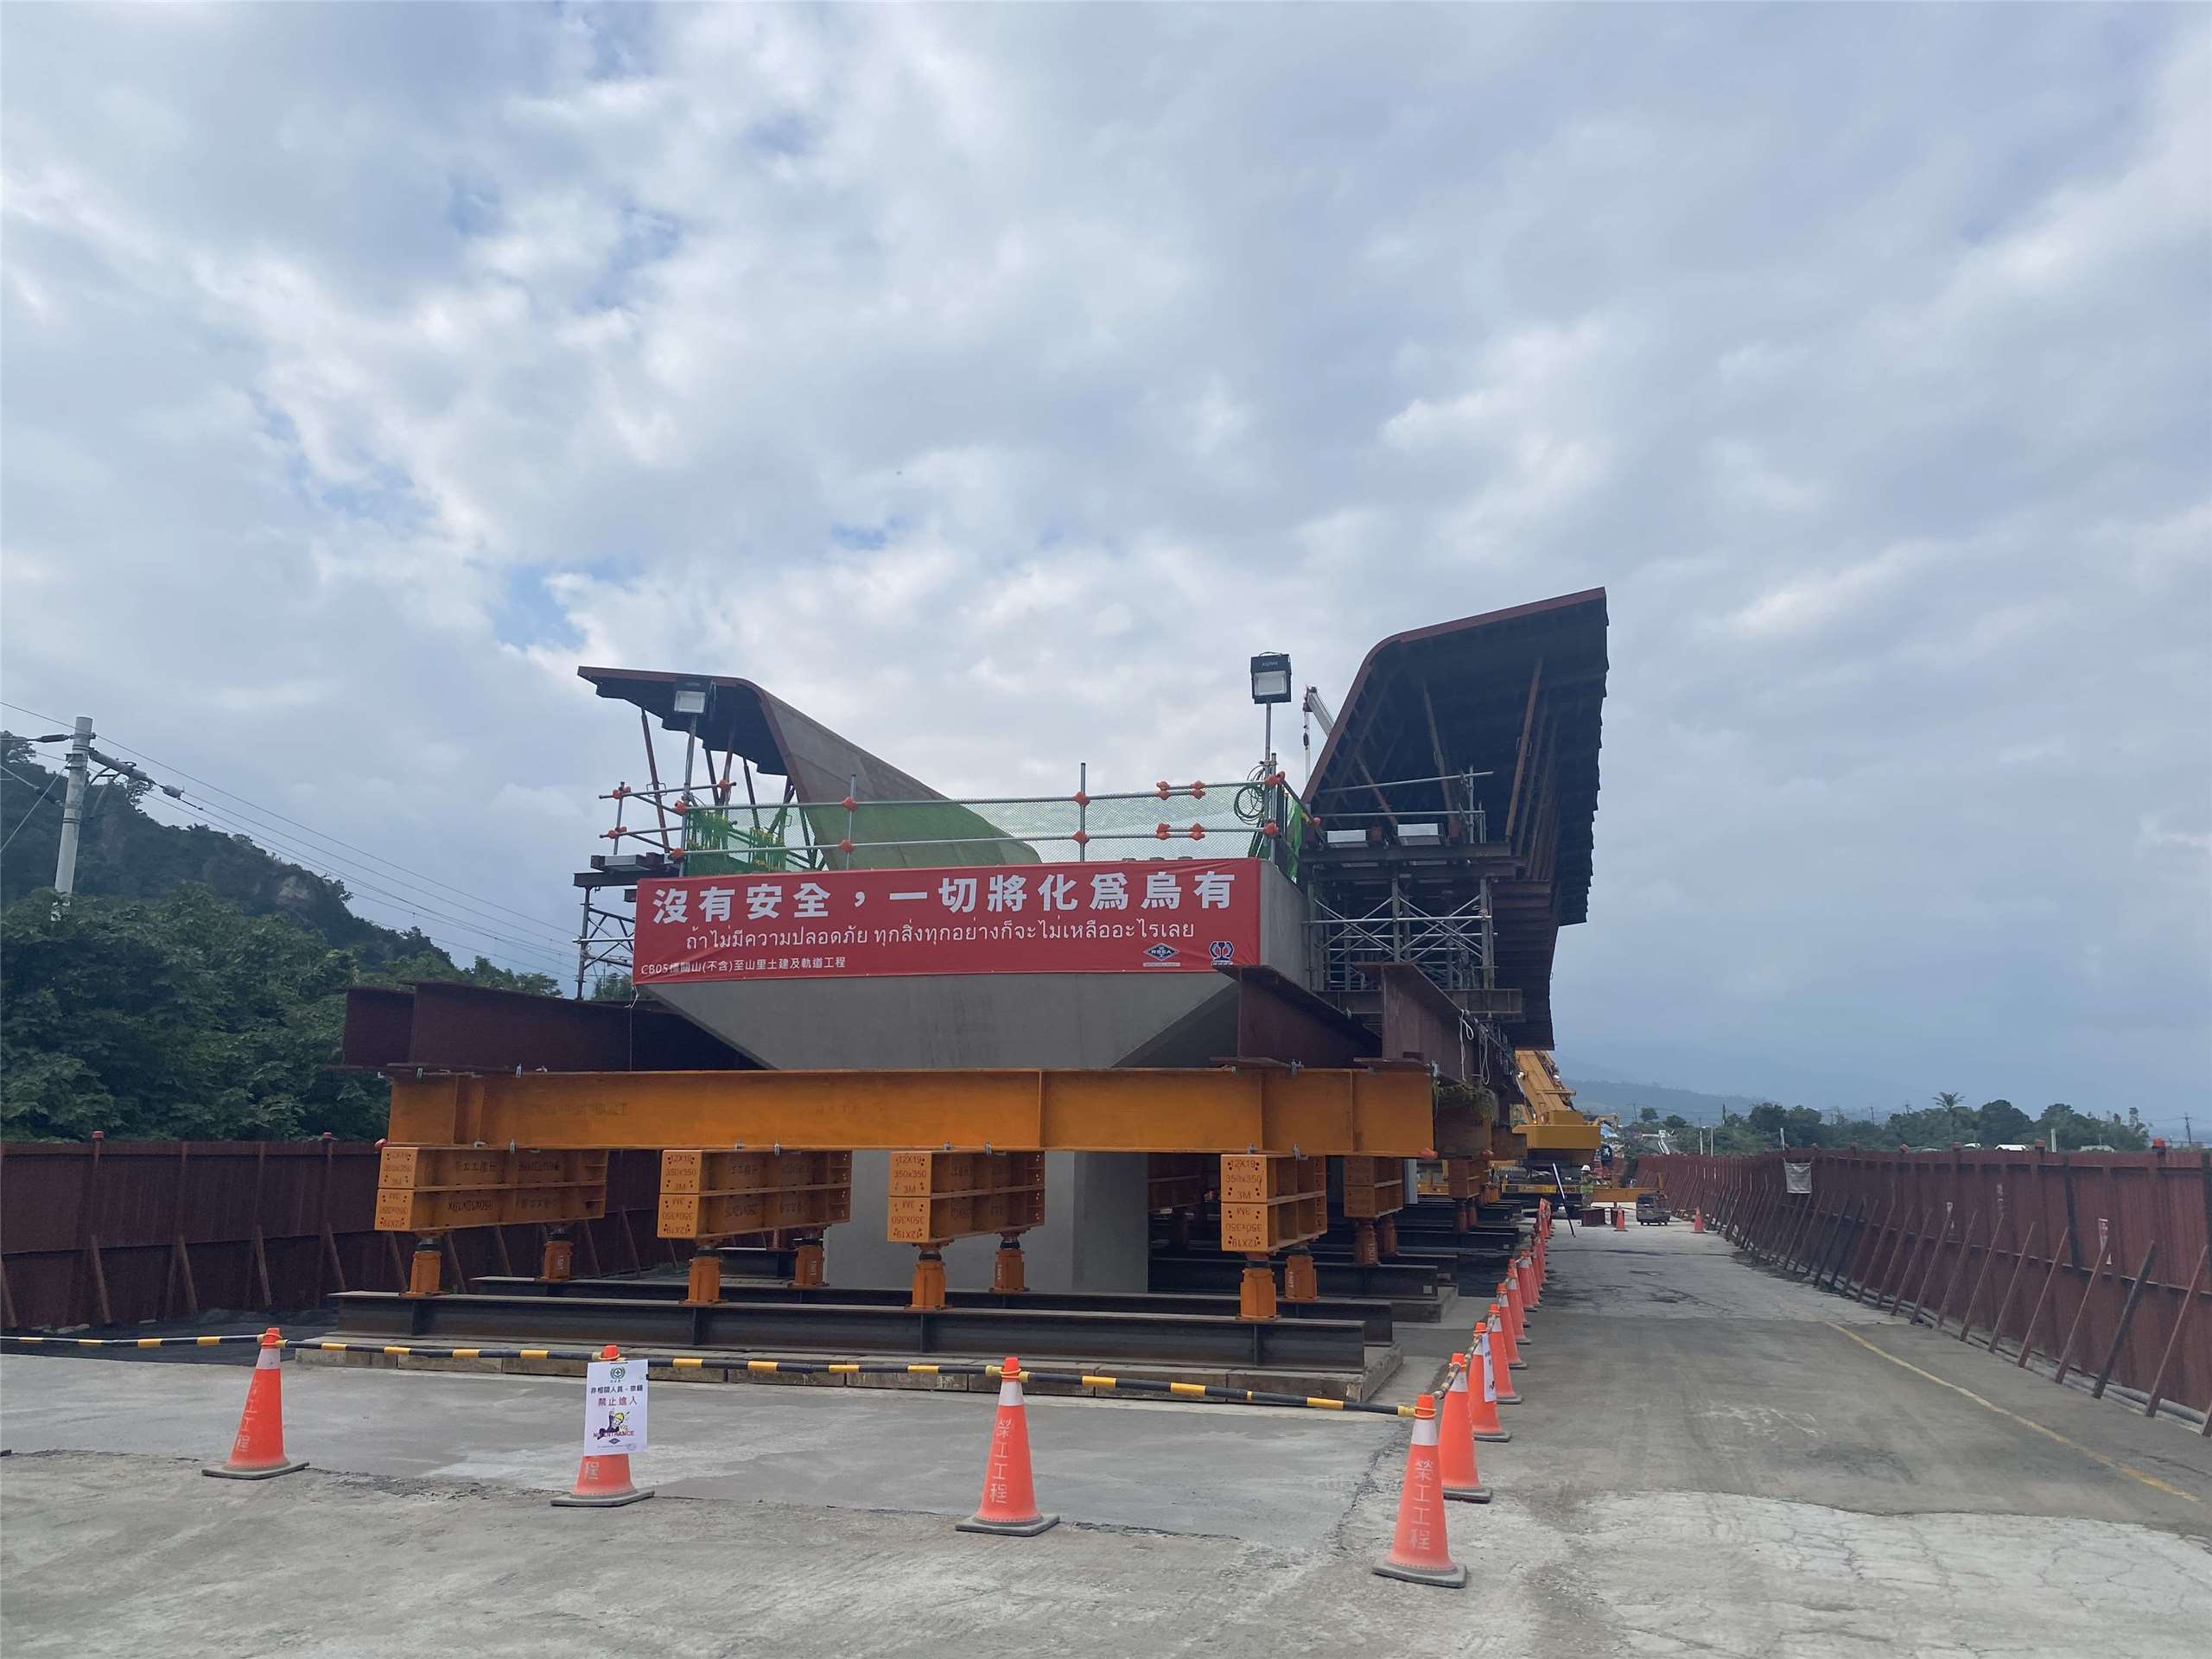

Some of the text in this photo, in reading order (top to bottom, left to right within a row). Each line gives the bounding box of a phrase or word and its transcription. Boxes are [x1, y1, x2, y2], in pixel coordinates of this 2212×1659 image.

[686, 914, 1195, 950] ถ้าไม่มีความปลอดภัย ทุกสิ่งทุกอย่างก็จะไม่เหลืออะไรเลย
